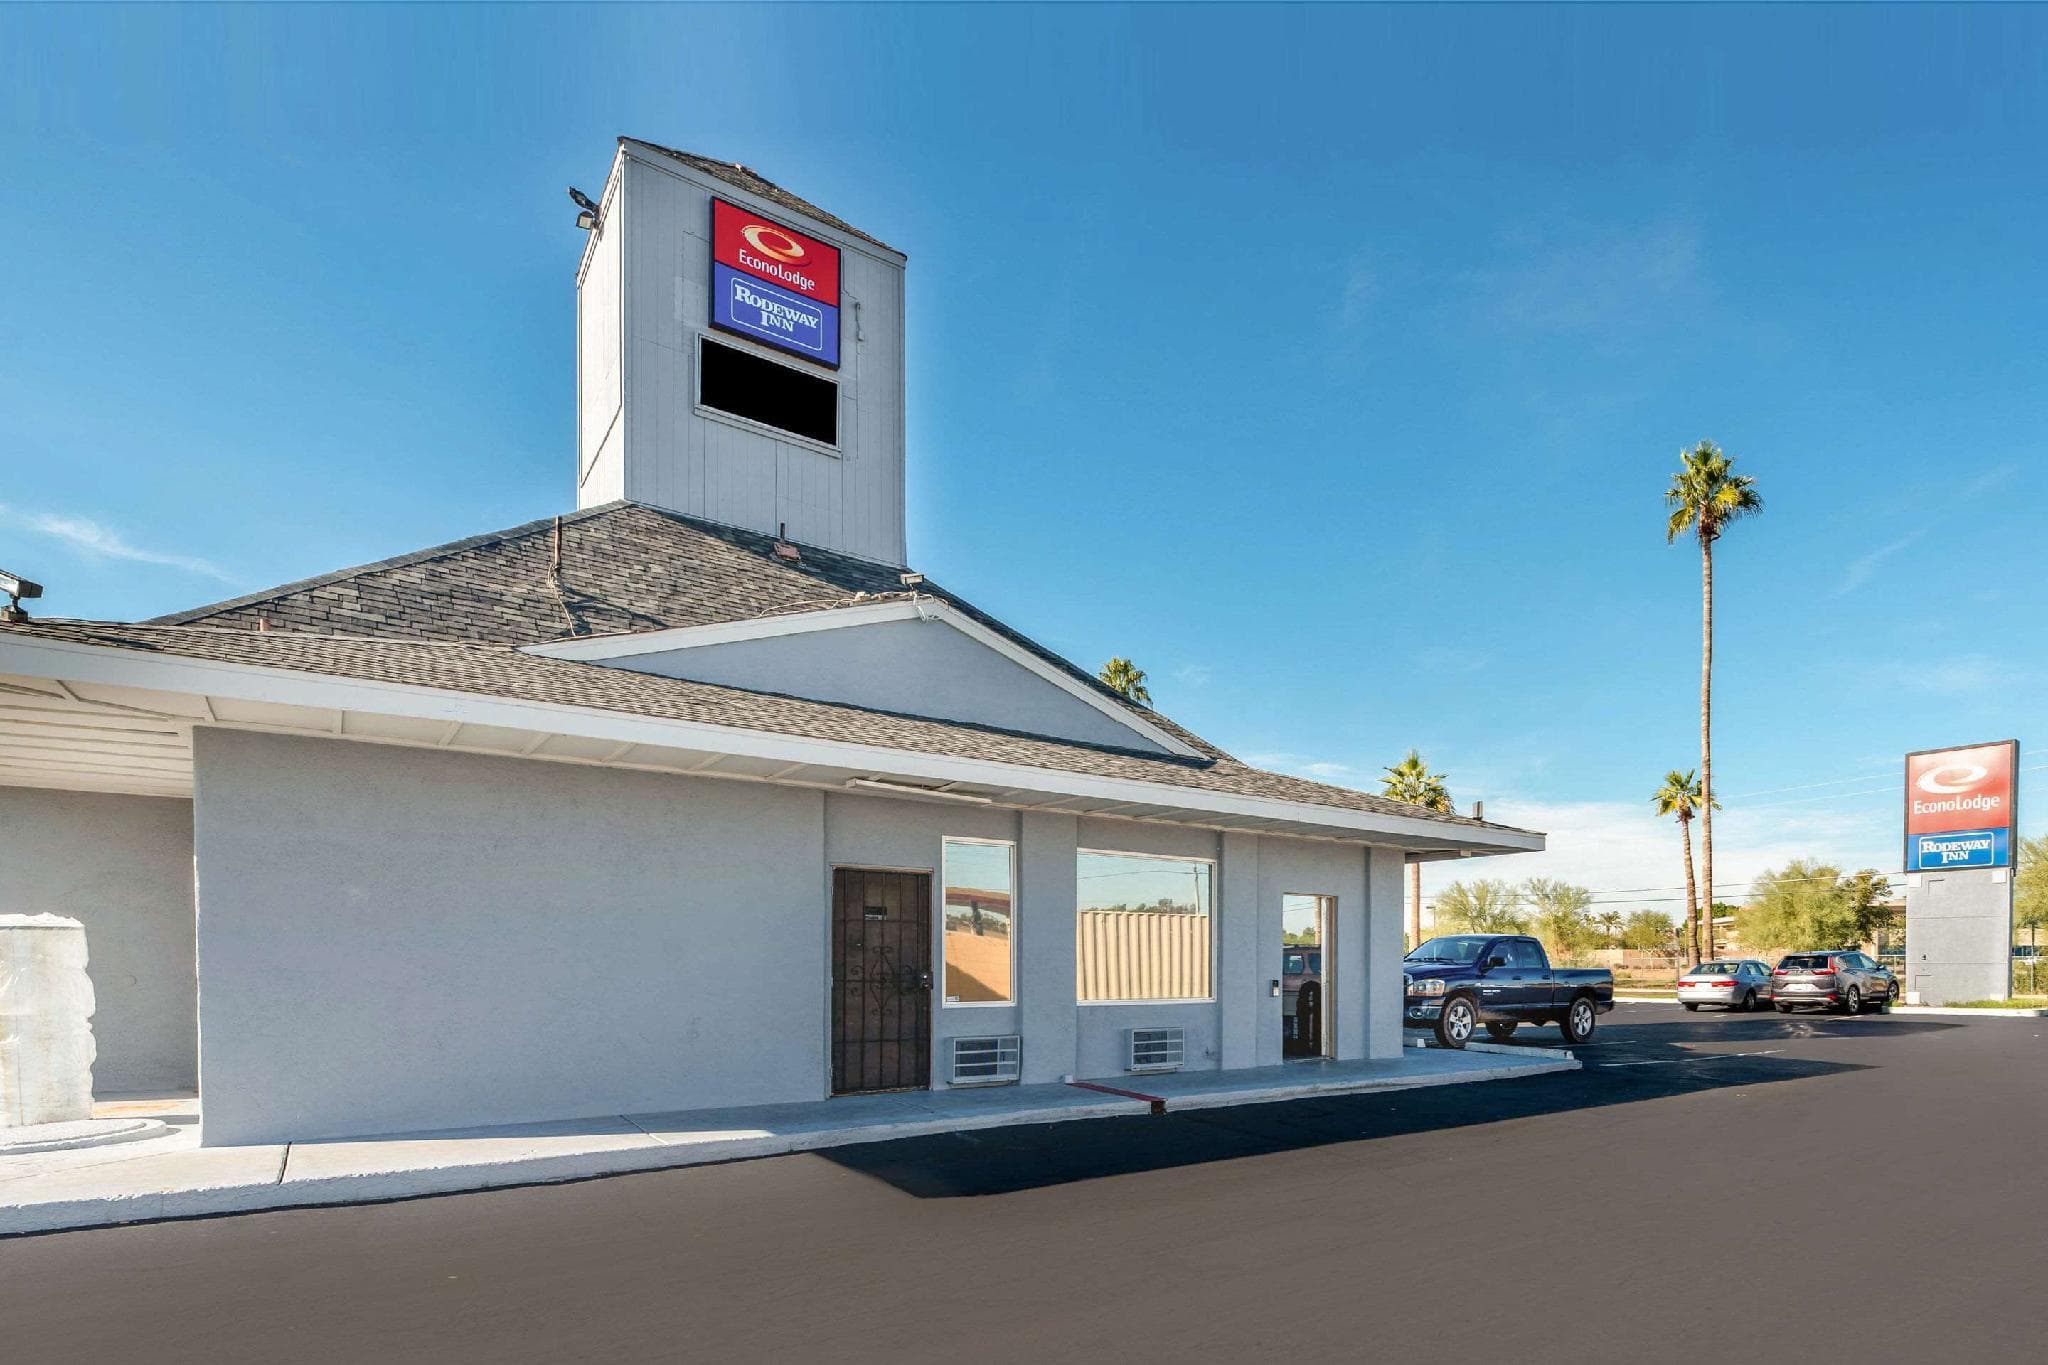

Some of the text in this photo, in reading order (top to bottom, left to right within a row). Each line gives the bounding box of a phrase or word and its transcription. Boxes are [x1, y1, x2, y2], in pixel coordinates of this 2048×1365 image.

[739, 248, 815, 291] EconoLodge
[734, 284, 819, 328] RODEWAY
[761, 311, 795, 332] INN
[1913, 793, 2001, 815] EconoLodge
[1921, 839, 1991, 853] RODEWAY
[1941, 850, 1970, 864] INN
